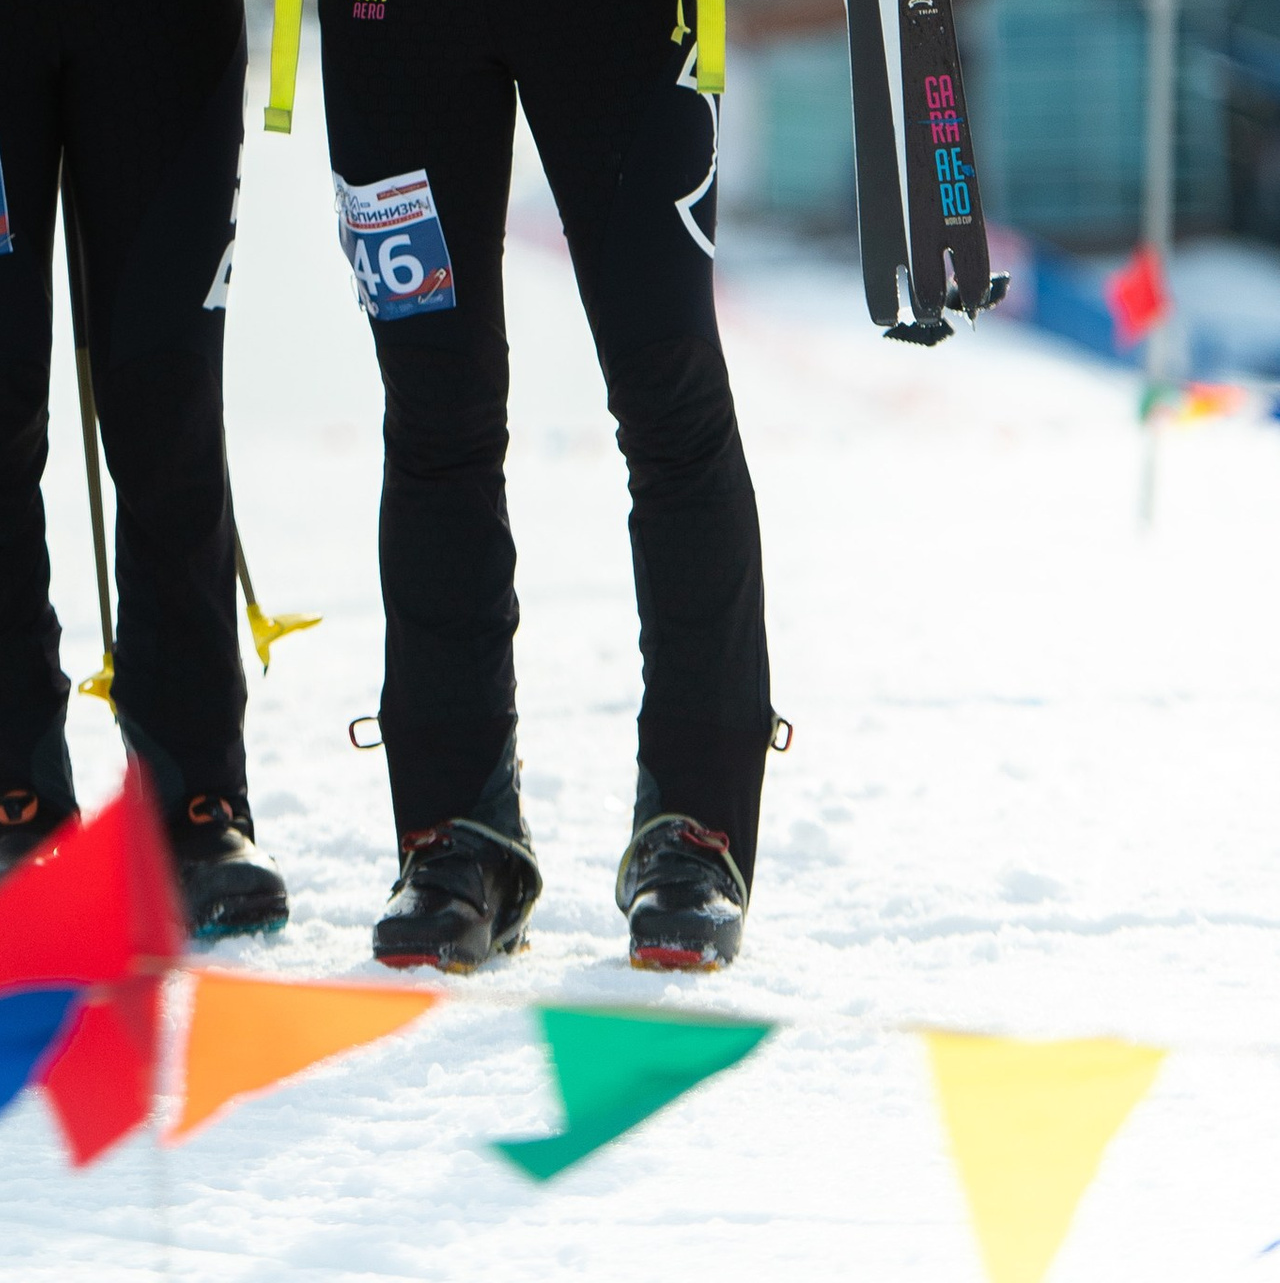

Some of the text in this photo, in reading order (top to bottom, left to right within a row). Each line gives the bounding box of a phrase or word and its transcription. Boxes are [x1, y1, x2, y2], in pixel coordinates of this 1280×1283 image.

[353, 2, 385, 20] AERO
[925, 74, 955, 109] GA
[935, 147, 965, 182] AE
[940, 182, 970, 216] RO
[354, 233, 424, 296] 46
